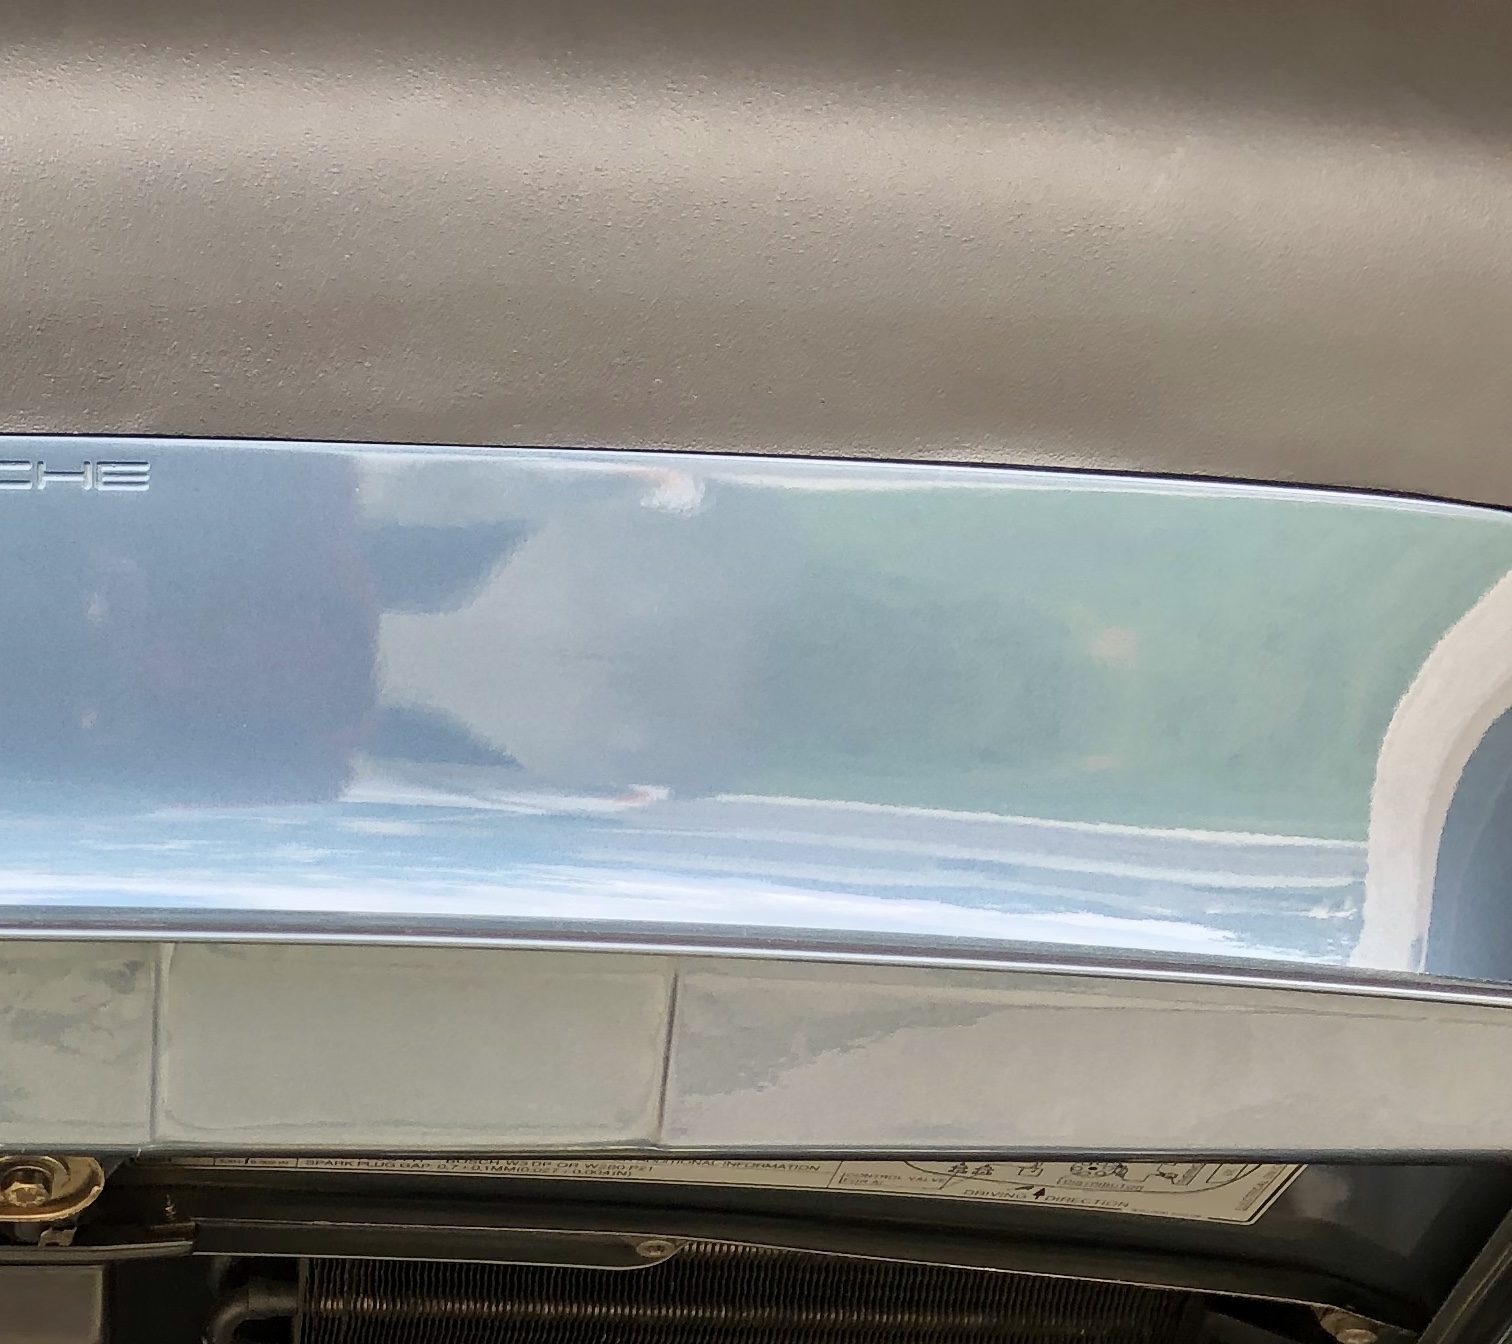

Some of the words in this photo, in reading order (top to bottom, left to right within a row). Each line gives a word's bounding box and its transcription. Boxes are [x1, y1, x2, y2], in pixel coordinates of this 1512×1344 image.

[723, 1161, 821, 1171] INFORMATION
[964, 1189, 1027, 1199] DRIVING
[1044, 1195, 1129, 1207] DIRECTION
